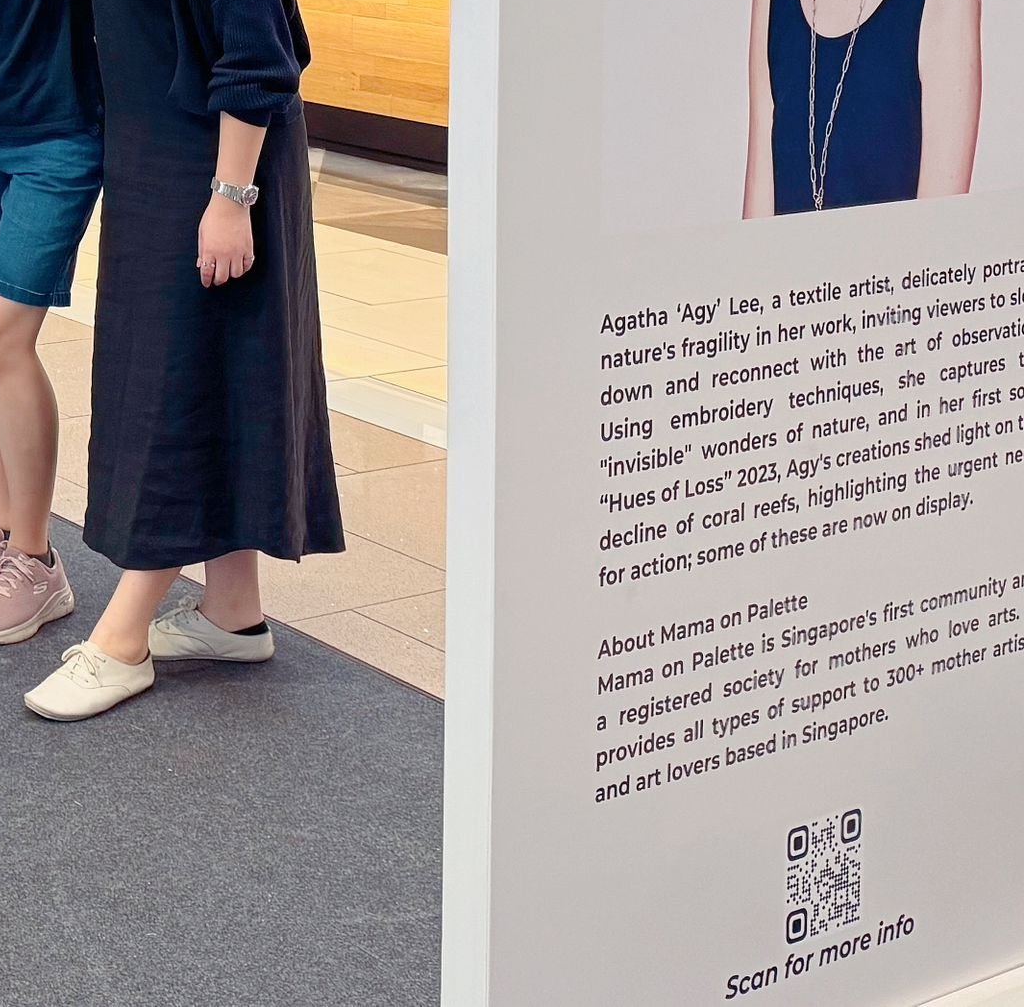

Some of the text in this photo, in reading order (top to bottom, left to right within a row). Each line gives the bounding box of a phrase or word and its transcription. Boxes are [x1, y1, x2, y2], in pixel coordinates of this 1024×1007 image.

[599, 306, 668, 337] Agatha
[729, 296, 764, 316] Lee,
[771, 294, 782, 310] a
[788, 281, 842, 307] textile
[848, 274, 895, 298] artist,
[901, 262, 977, 290] delicately
[601, 341, 676, 370] nature's
[681, 329, 751, 359] fragility
[756, 325, 772, 347] in
[777, 323, 806, 343] her
[810, 313, 857, 338] work,
[861, 304, 922, 330] inviting
[926, 297, 986, 319] viewers
[989, 292, 1006, 310] to
[600, 383, 653, 407] down
[665, 370, 700, 396] and
[711, 357, 800, 389] reconnect
[810, 348, 847, 372] with
[857, 343, 885, 364] the
[894, 337, 917, 358] art
[926, 330, 943, 352] of
[600, 416, 653, 442] Using
[670, 397, 774, 430] embroidery
[788, 379, 884, 410] techniques,
[898, 369, 926, 390] she
[939, 357, 1006, 384] captures
[661, 479, 681, 503] of
[736, 461, 782, 488] 2023,
[785, 452, 832, 480] Agy's
[835, 439, 911, 468] creations
[914, 426, 952, 452] shed
[956, 421, 991, 446] light
[994, 419, 1014, 436] on
[701, 431, 778, 460] wonders
[786, 421, 804, 444] of
[812, 415, 870, 440] nature,
[878, 402, 908, 427] and
[916, 399, 931, 420] in
[939, 396, 965, 415] her
[971, 387, 1002, 409] first
[598, 491, 974, 588] for action; some of these are now on display.
[599, 521, 668, 552] decline
[675, 512, 695, 535] of
[702, 501, 745, 530] coral
[753, 492, 800, 519] reefs,
[808, 471, 907, 509] highlighting
[914, 464, 941, 485] the
[947, 451, 999, 479] urgent
[596, 607, 1020, 732] a registered society for mothers who love arts.
[597, 594, 809, 660] About Mama on Palette
[597, 667, 654, 696] Mama
[661, 659, 684, 679] on
[692, 642, 755, 672] Palette
[761, 632, 775, 654] is
[781, 609, 877, 649] Singapore's
[882, 599, 915, 623] first
[919, 576, 1008, 613] community
[595, 731, 676, 773] provides
[683, 718, 704, 743] all
[711, 709, 760, 739] types
[767, 696, 785, 720] of
[791, 680, 857, 714] support
[863, 676, 880, 694] to
[886, 663, 925, 688] 300+
[931, 647, 988, 676] mother
[594, 708, 889, 804] and art lovers based in Singapore.
[725, 913, 915, 1000] Scan for more info
